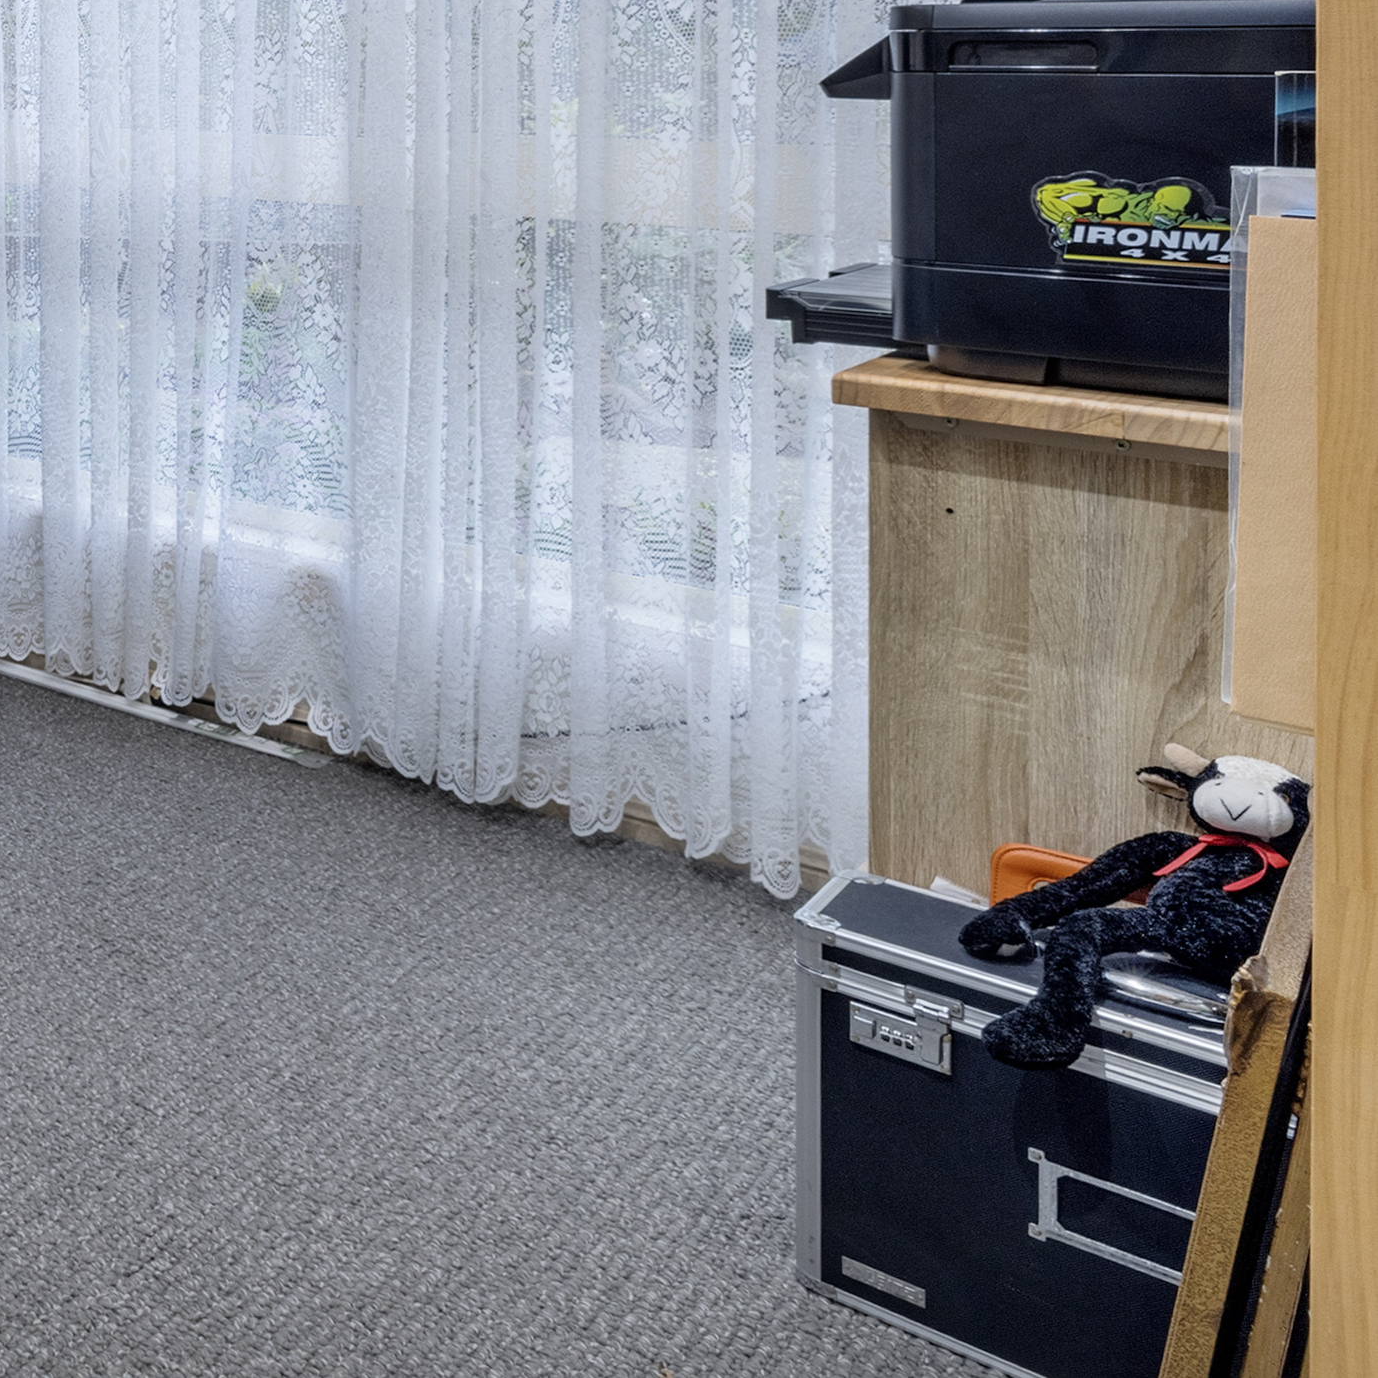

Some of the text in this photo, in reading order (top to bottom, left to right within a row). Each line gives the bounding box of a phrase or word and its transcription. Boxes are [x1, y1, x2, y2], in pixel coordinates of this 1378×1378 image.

[1120, 249, 1230, 263] 4 X 4
